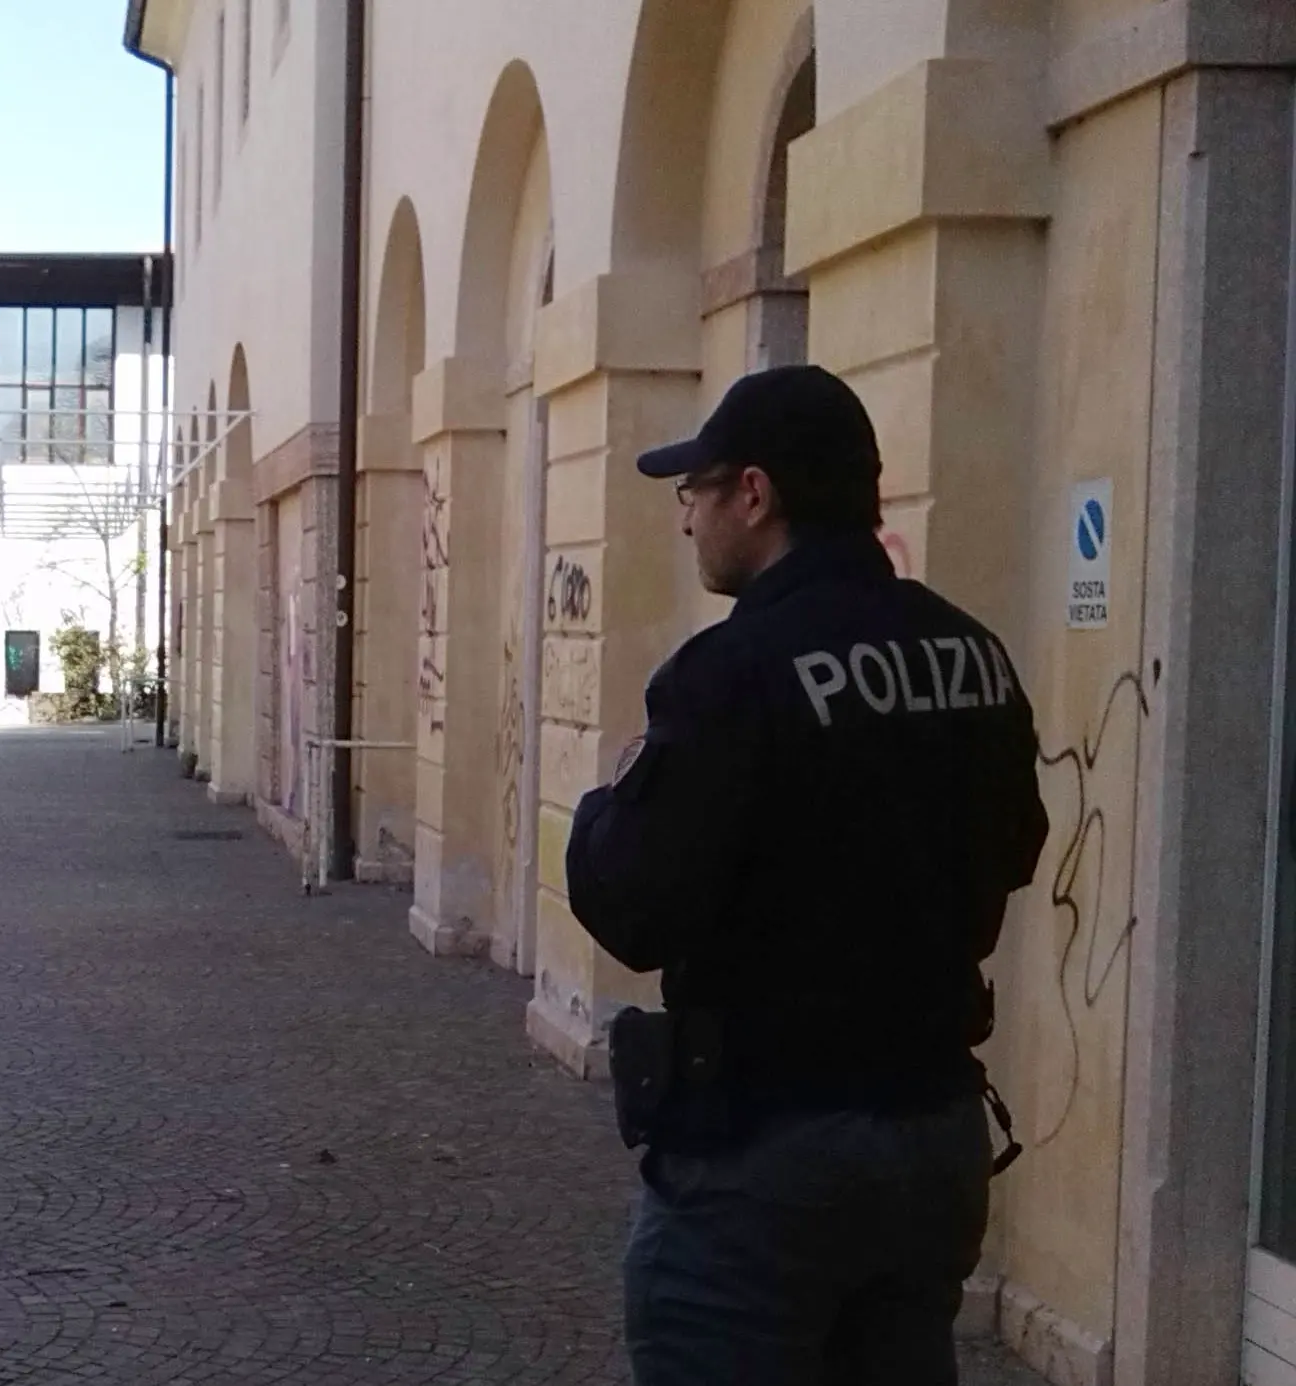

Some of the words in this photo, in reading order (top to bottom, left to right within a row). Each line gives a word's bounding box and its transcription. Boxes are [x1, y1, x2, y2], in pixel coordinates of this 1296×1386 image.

[1072, 580, 1106, 599] SOSTA
[1069, 603, 1108, 622] VIETATA
[793, 636, 1016, 728] POLIZIA
